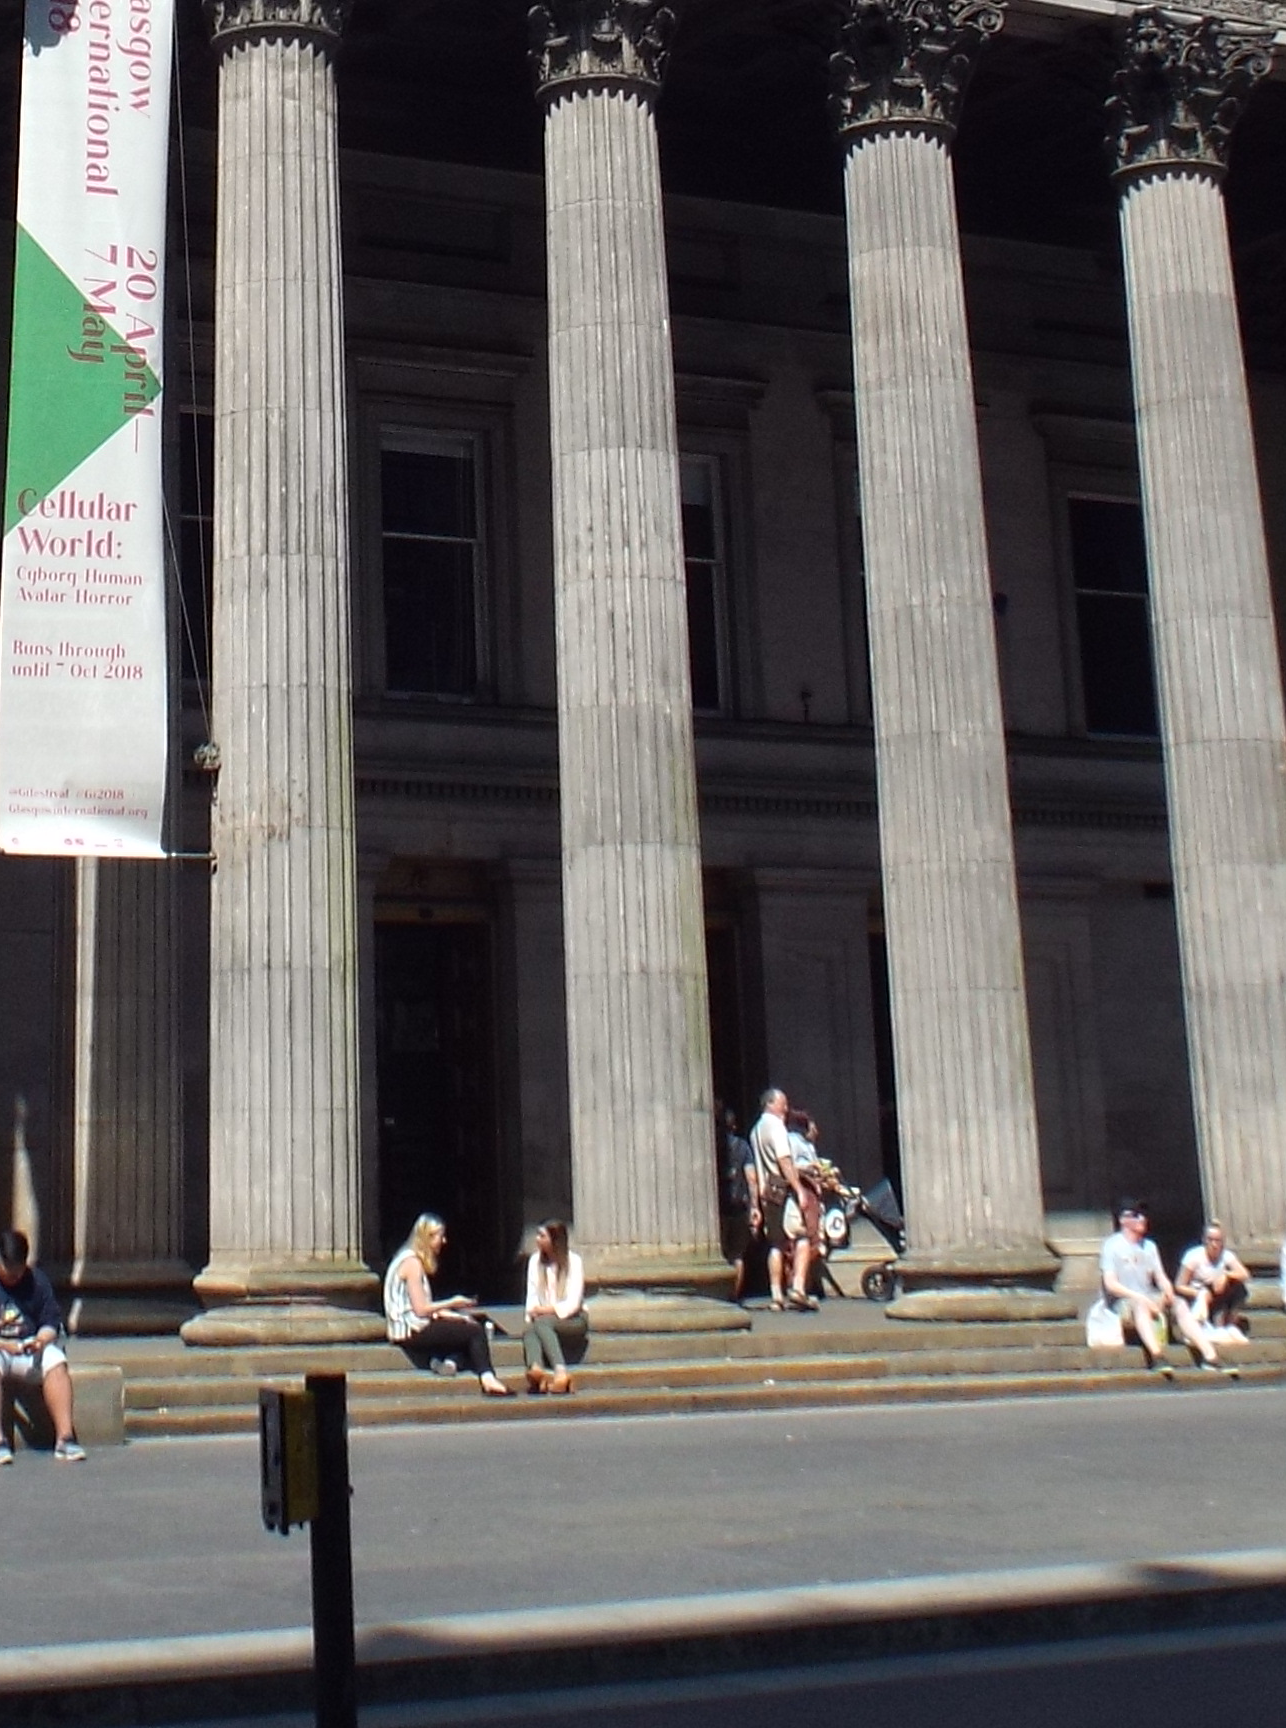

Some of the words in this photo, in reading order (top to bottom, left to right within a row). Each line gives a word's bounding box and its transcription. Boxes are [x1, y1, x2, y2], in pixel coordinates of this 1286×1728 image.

[84, 244, 117, 266] 7
[126, 246, 158, 301] 20
[66, 277, 116, 363] May
[110, 312, 155, 417] April
[17, 487, 138, 522] Cellular
[17, 526, 123, 560] World:
[16, 565, 77, 587] Cyborg
[85, 568, 143, 586] Human
[18, 586, 67, 603] Avatar
[75, 588, 133, 606] Horror
[13, 639, 53, 656] Runs
[58, 641, 126, 663] through
[12, 662, 50, 678] until
[70, 663, 98, 679] Oct
[103, 664, 144, 680] 2018
